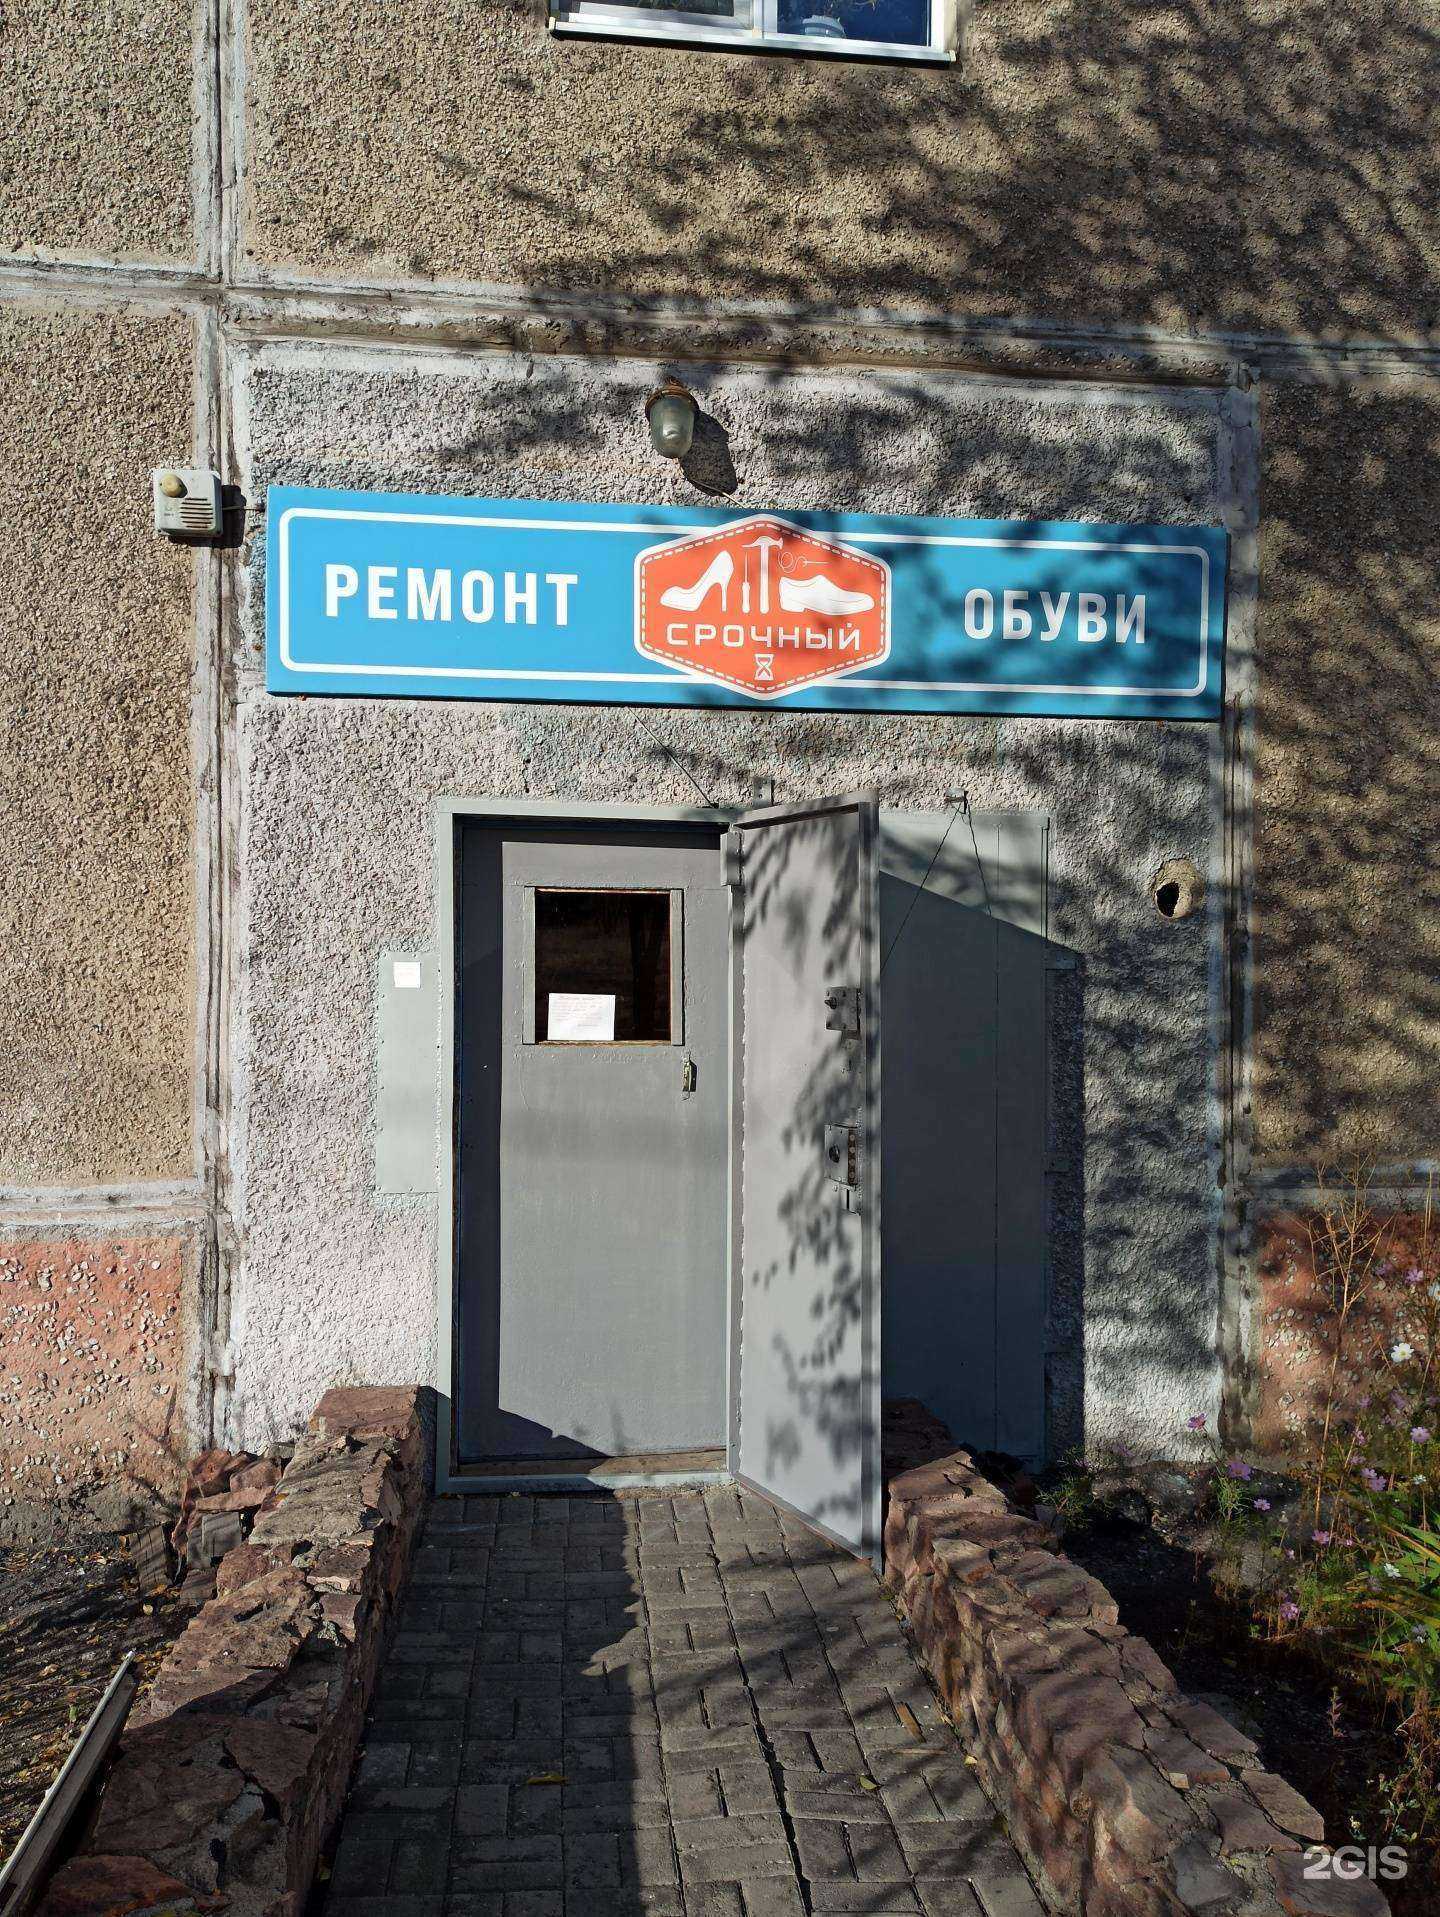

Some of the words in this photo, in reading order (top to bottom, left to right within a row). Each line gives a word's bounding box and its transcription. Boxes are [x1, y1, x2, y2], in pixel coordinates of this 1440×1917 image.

[325, 564, 578, 626] РЕМОНТ
[964, 588, 1146, 643] ОБУВИ
[666, 623, 860, 651] СРОЧНЫЙ
